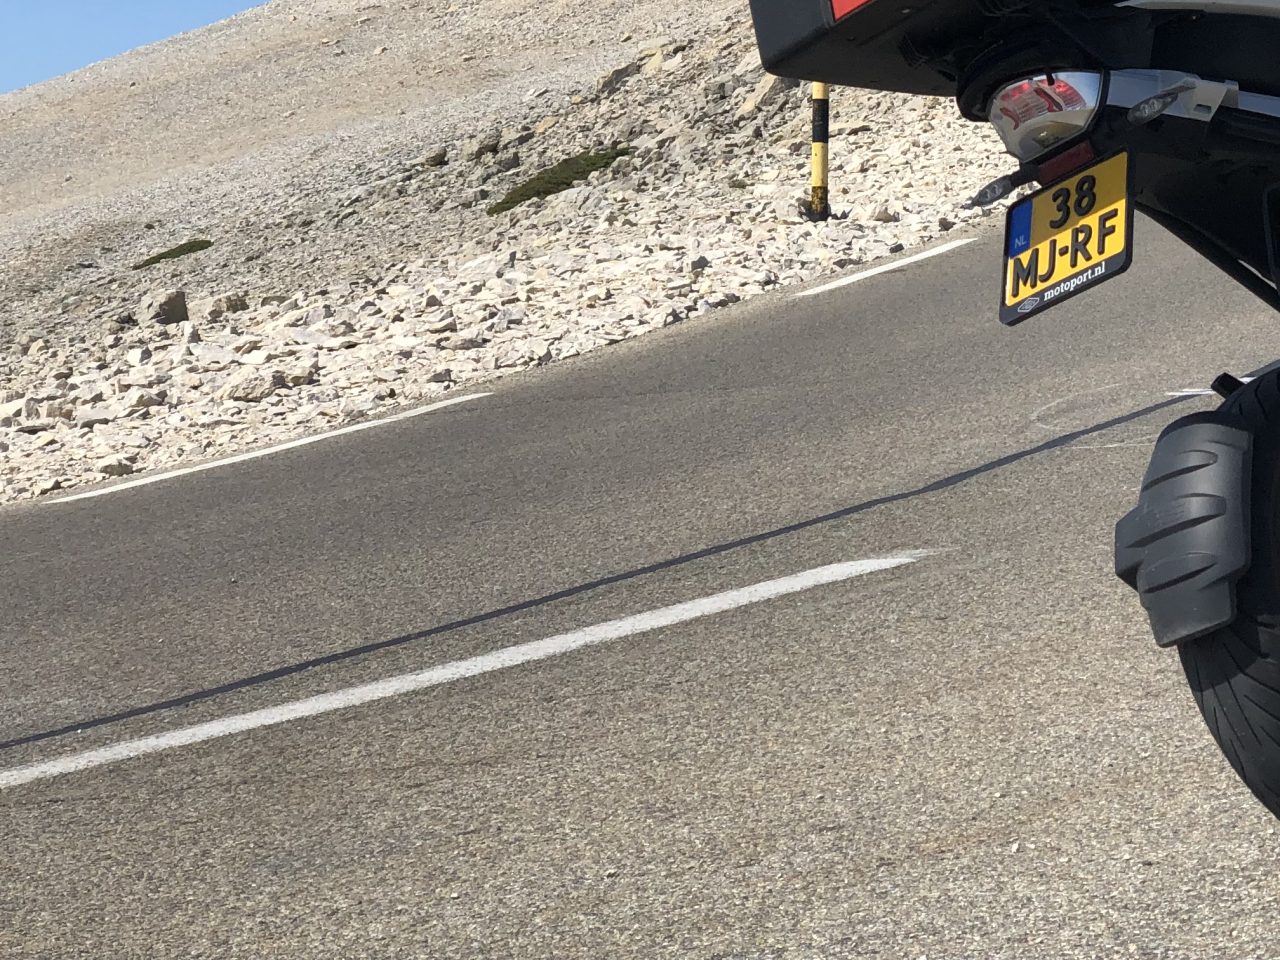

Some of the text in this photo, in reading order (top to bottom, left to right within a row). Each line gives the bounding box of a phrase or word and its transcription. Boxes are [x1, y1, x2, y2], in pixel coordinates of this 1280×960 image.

[1049, 175, 1096, 229] 38
[1011, 208, 1119, 298] MJ-RF
[1014, 236, 1027, 249] NL
[1043, 261, 1106, 301] motoport.nl
